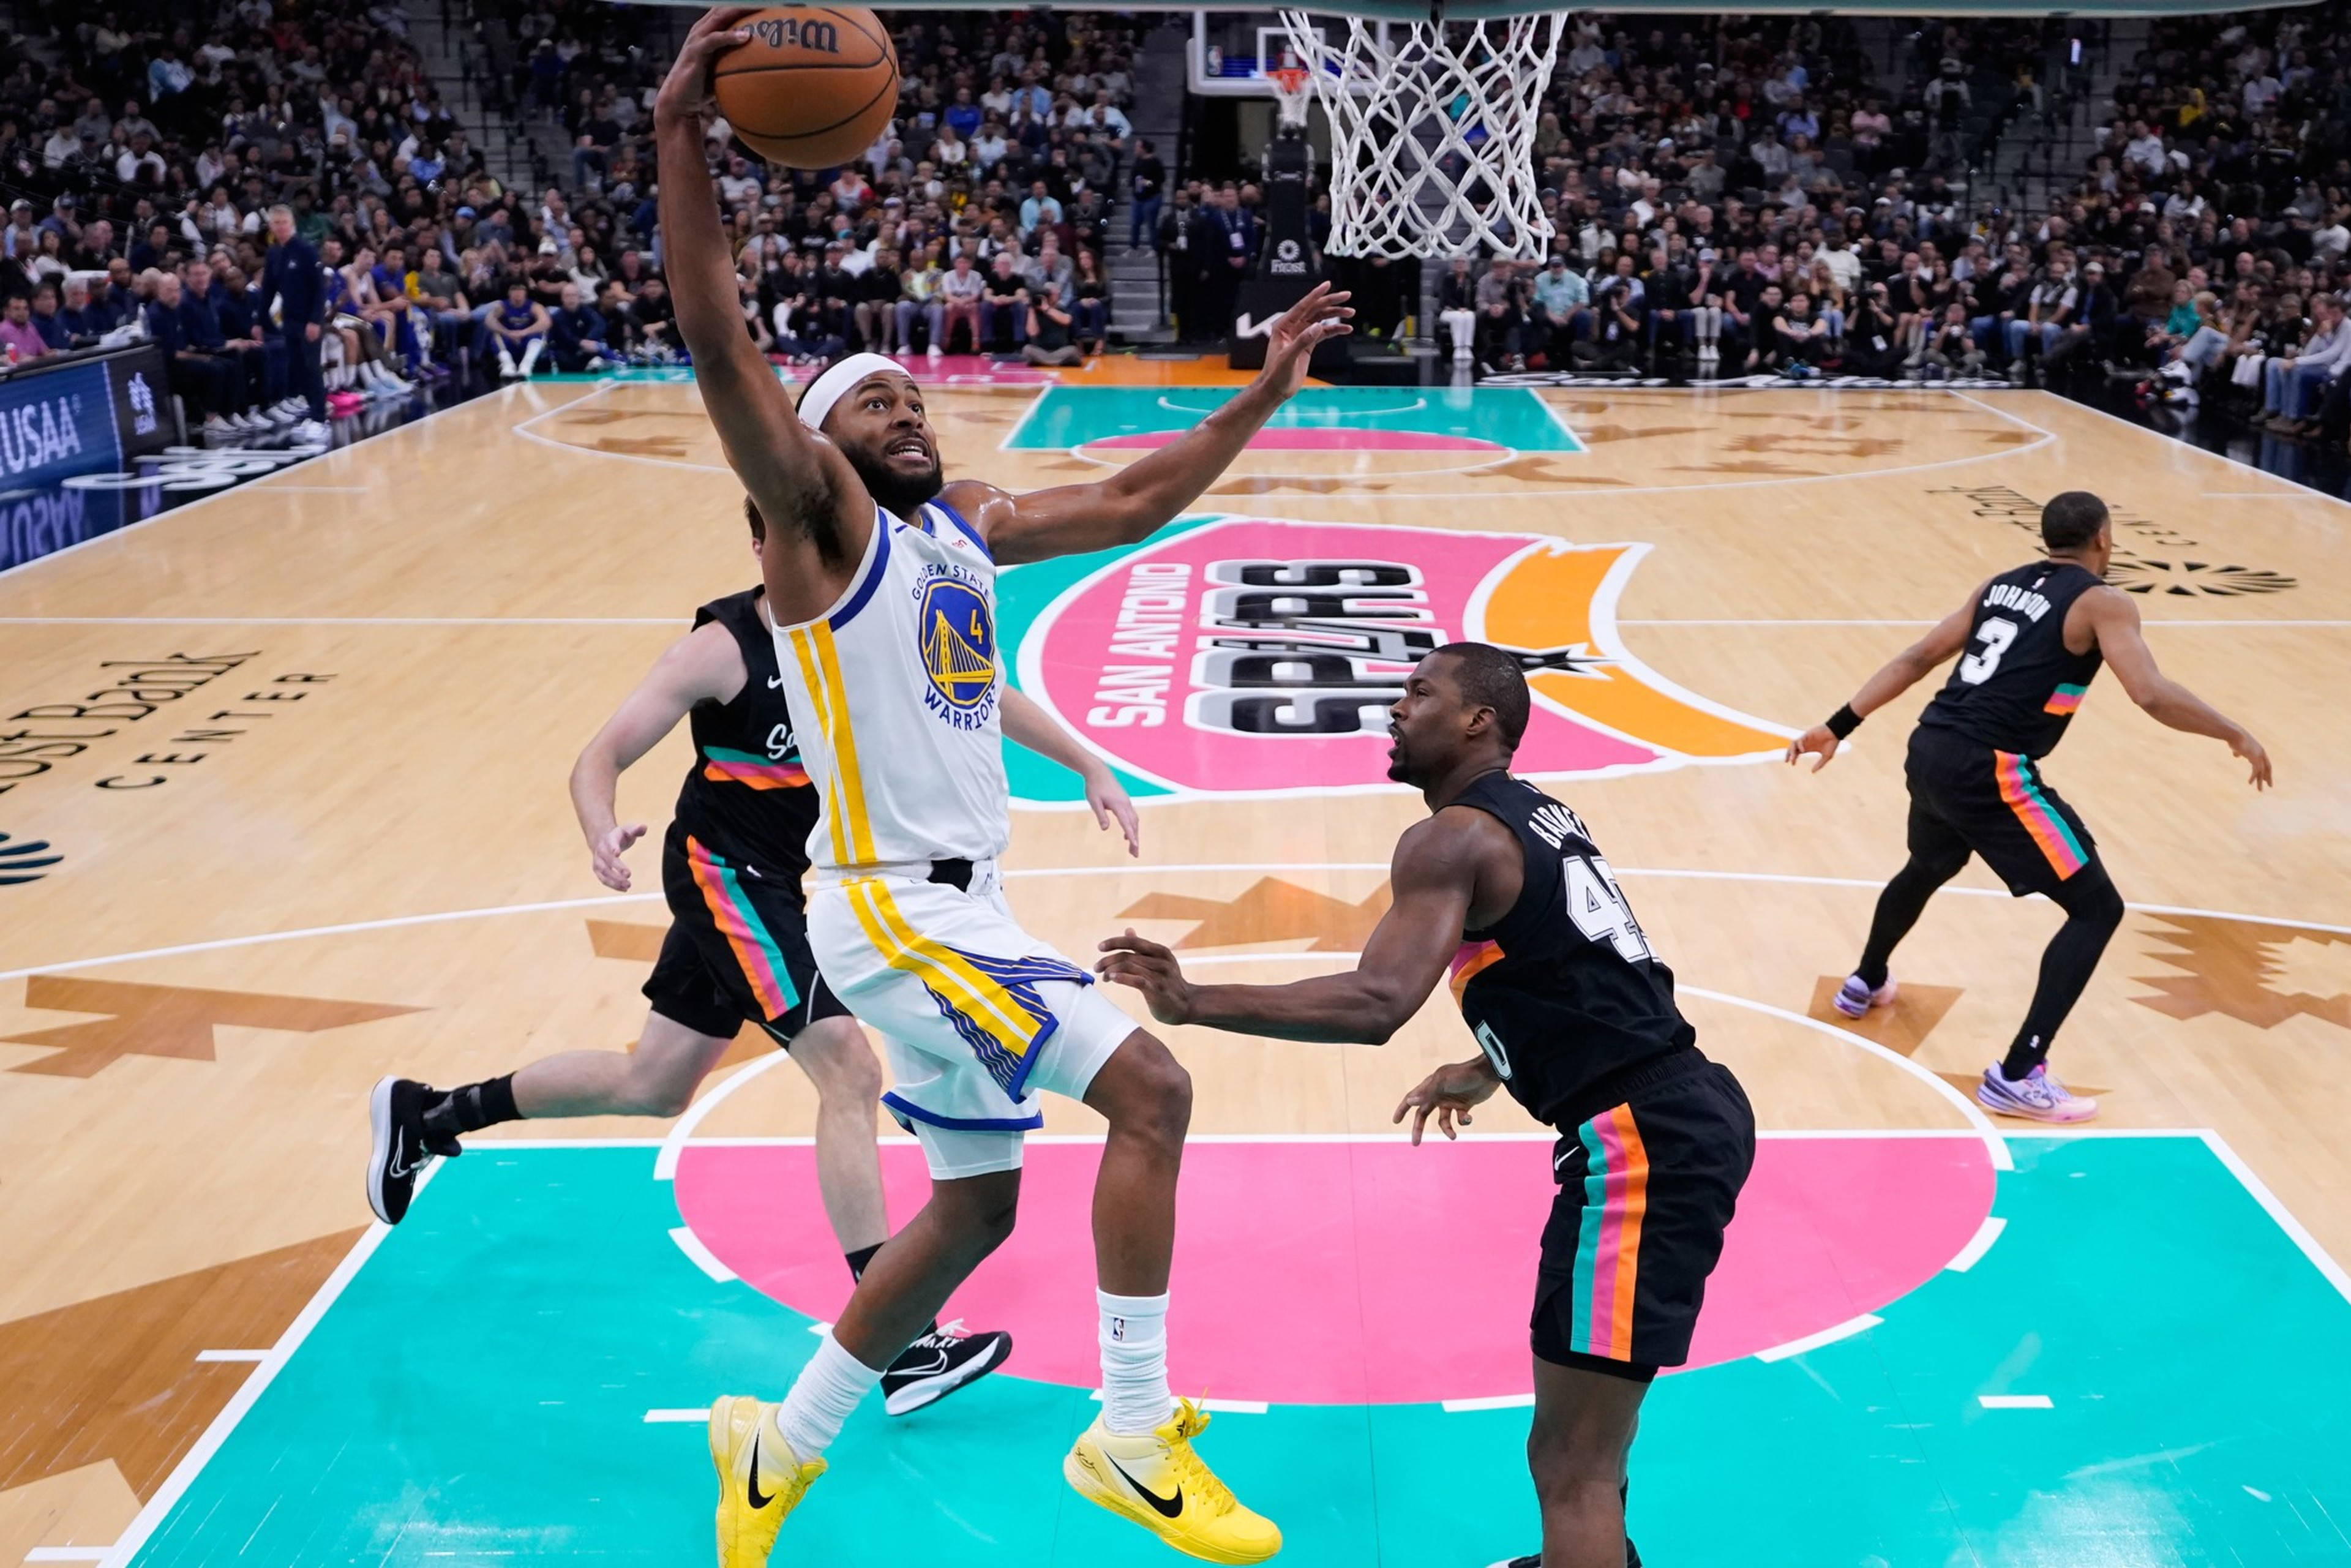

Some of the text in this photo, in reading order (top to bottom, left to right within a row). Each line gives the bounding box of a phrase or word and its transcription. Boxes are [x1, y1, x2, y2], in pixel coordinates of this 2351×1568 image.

[739, 18, 839, 53] Wils
[911, 563, 990, 601] GOLDEN STATE
[969, 609, 984, 644] 4
[1086, 563, 1192, 728] SAN ANTONIO
[1959, 615, 2019, 686] 3
[7, 650, 263, 721] Bank
[94, 673, 340, 790] CENTER
[766, 723, 797, 759] Sa
